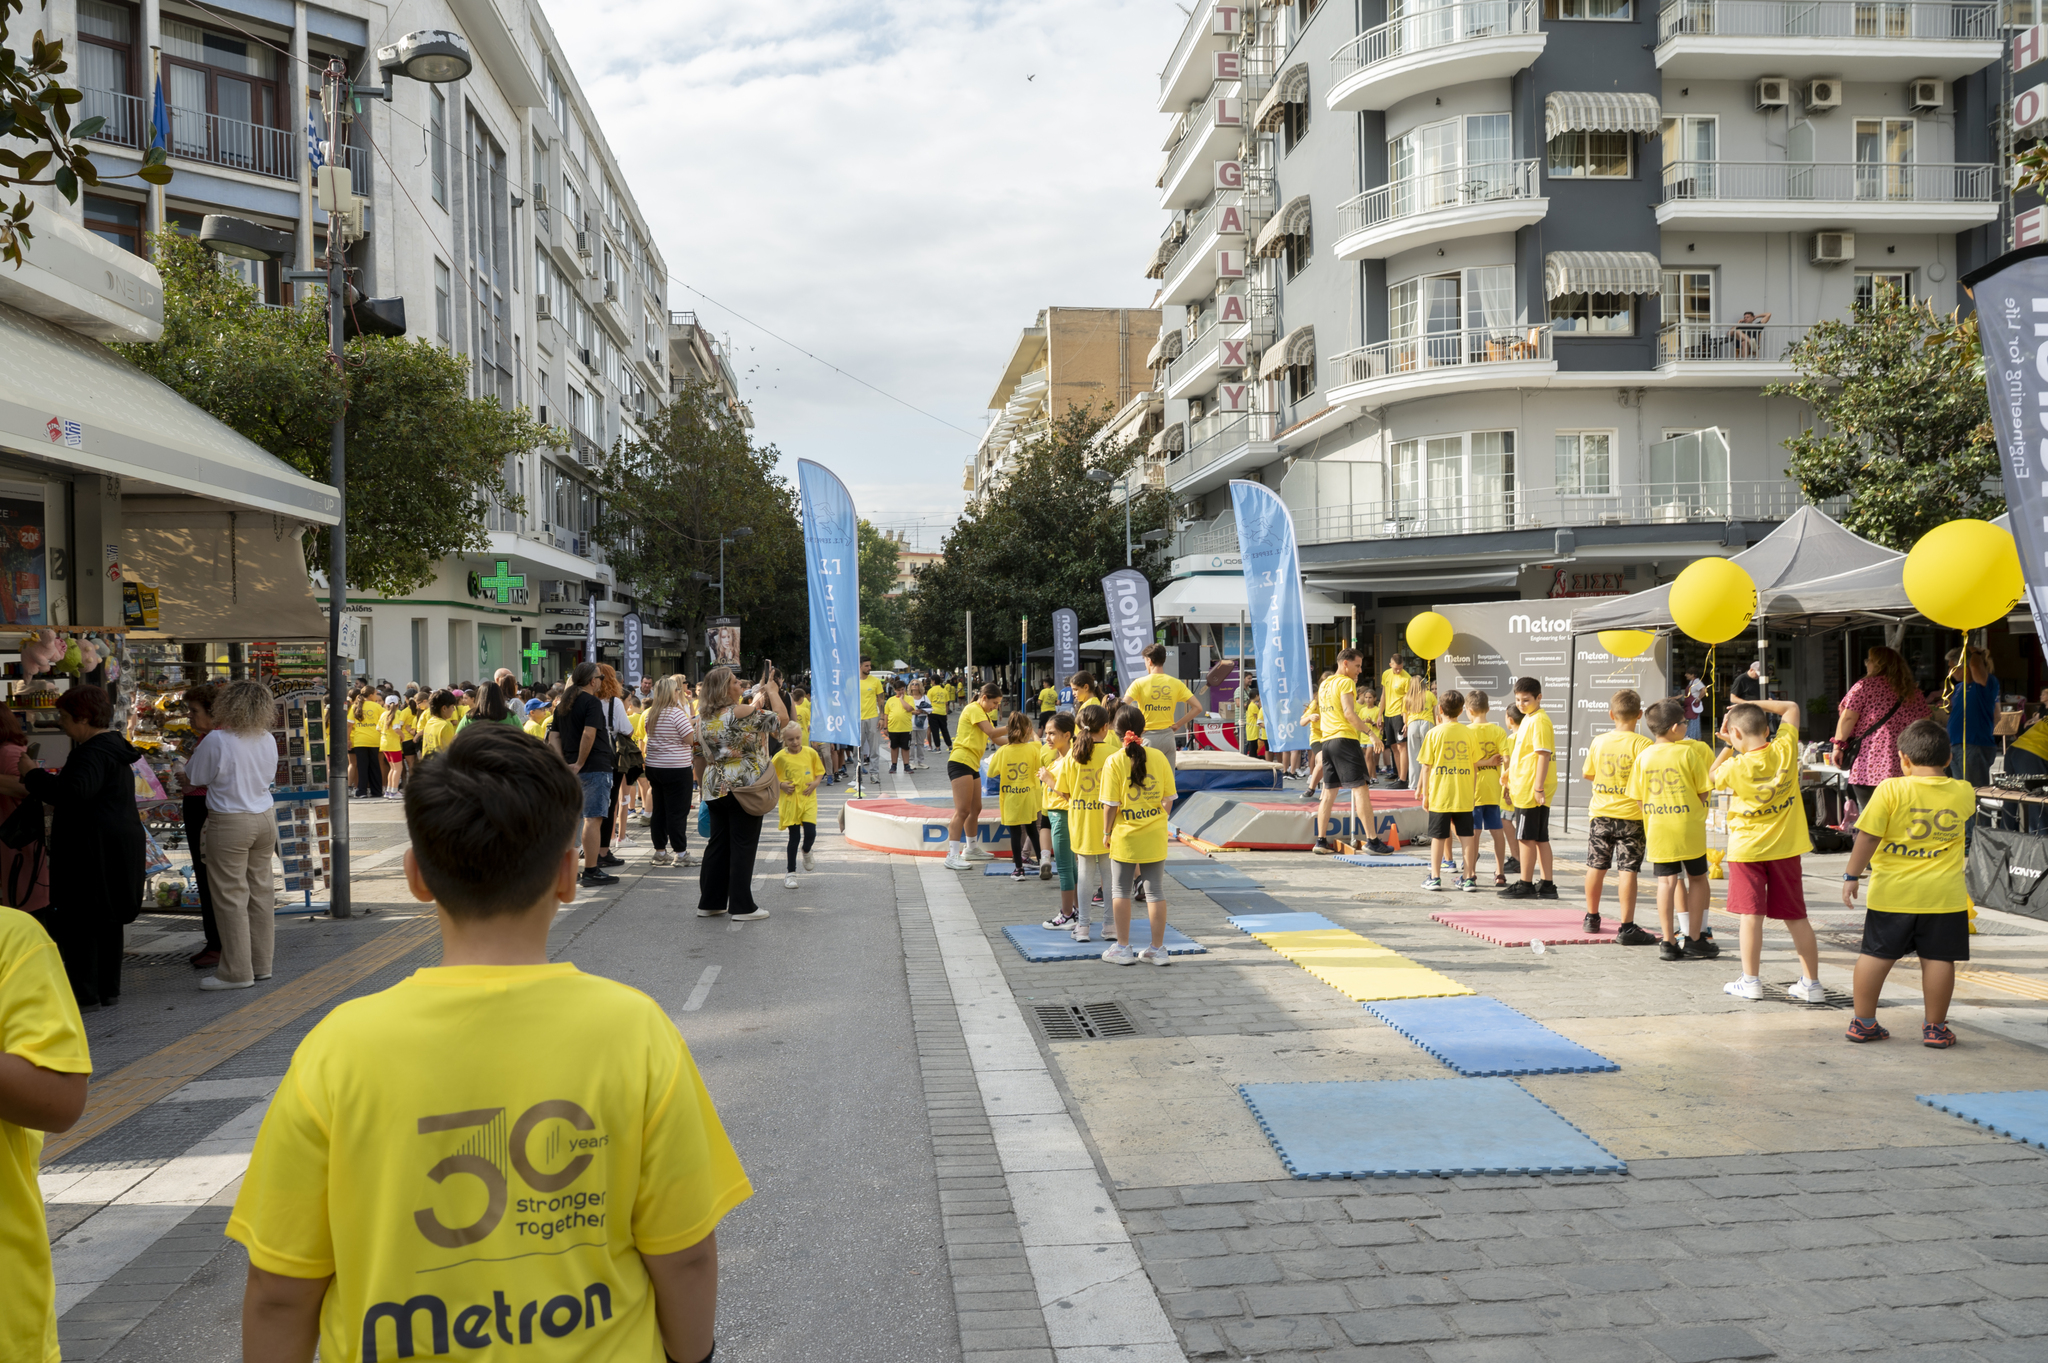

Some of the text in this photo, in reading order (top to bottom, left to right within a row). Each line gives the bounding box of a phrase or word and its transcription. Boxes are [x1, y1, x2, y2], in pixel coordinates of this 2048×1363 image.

[1219, 162, 1246, 409] GALAXY
[138, 286, 154, 308] UP
[324, 498, 335, 511] UP
[21, 532, 40, 543] 20€
[1572, 573, 1625, 590] ΣΙΣΣΥ
[1061, 690, 1071, 703] 20
[2009, 865, 2042, 878] VONYX
[568, 1133, 610, 1153] years
[515, 1190, 607, 1214] stronger
